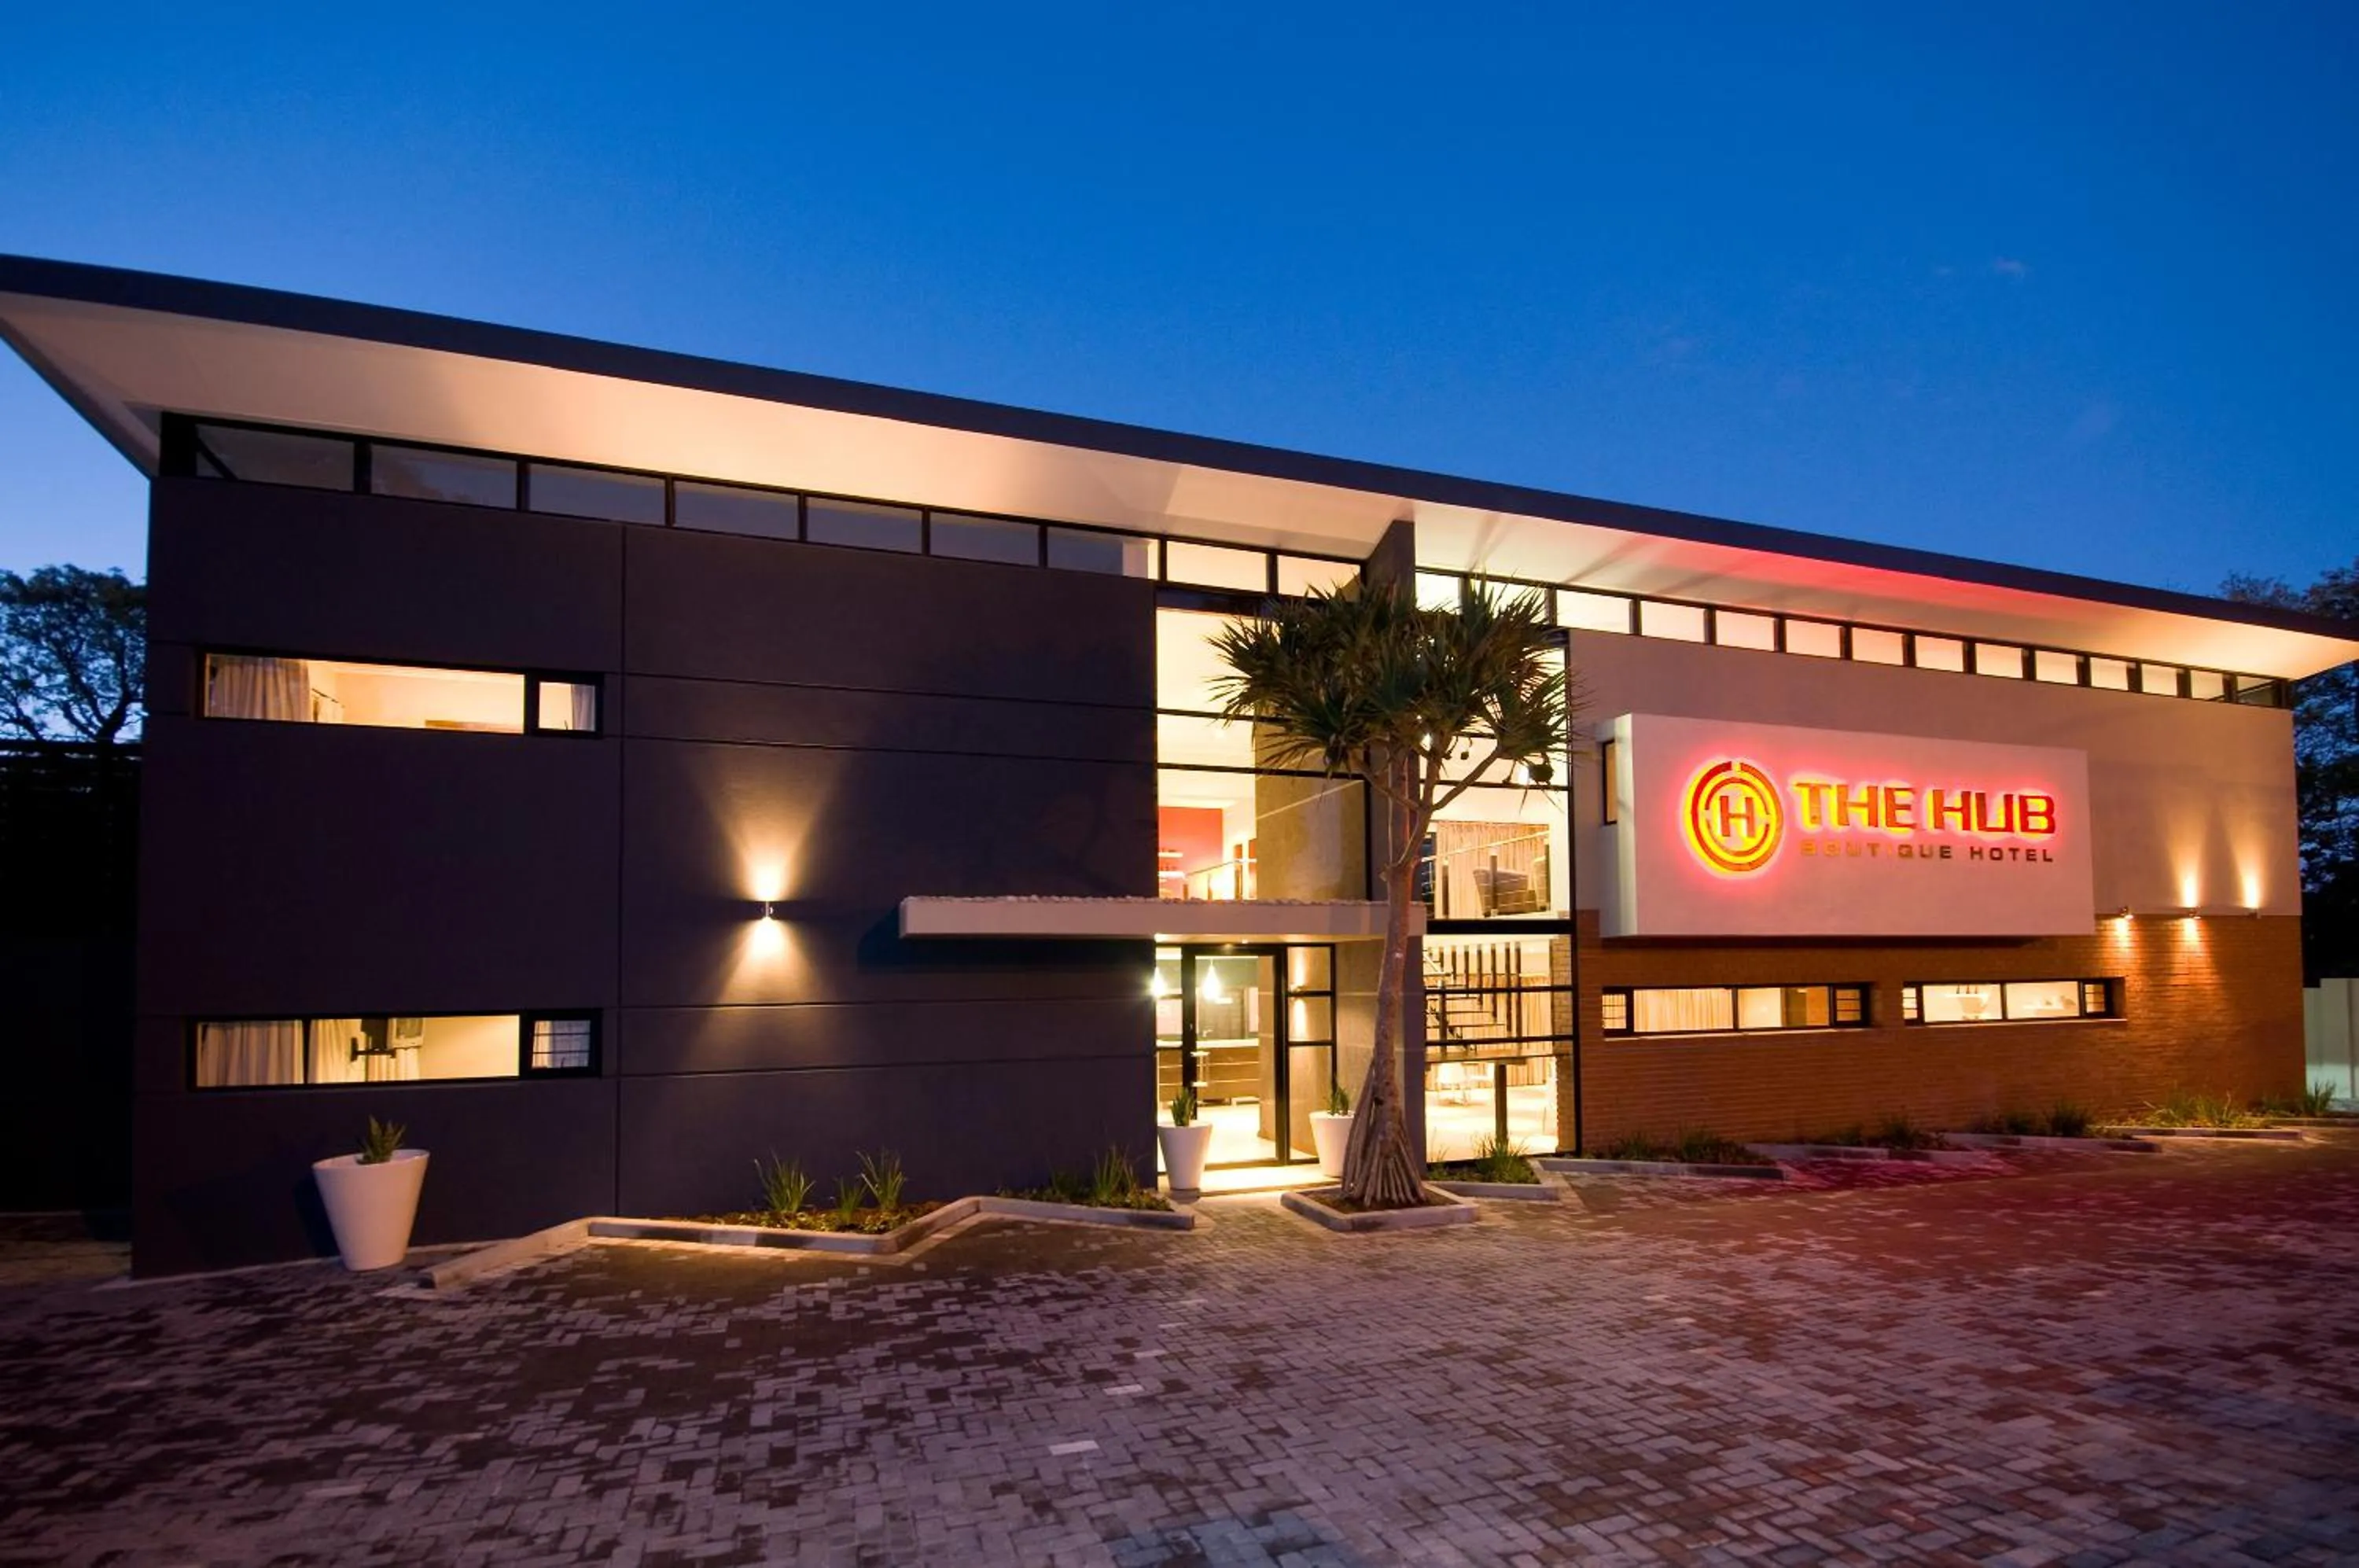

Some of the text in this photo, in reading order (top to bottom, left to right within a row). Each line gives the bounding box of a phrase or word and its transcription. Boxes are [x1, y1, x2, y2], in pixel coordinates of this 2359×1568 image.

[1719, 795, 1756, 838] H
[1795, 782, 2056, 834] THE HUB
[1800, 839, 2054, 863] BOUTIQUE HOTEL
